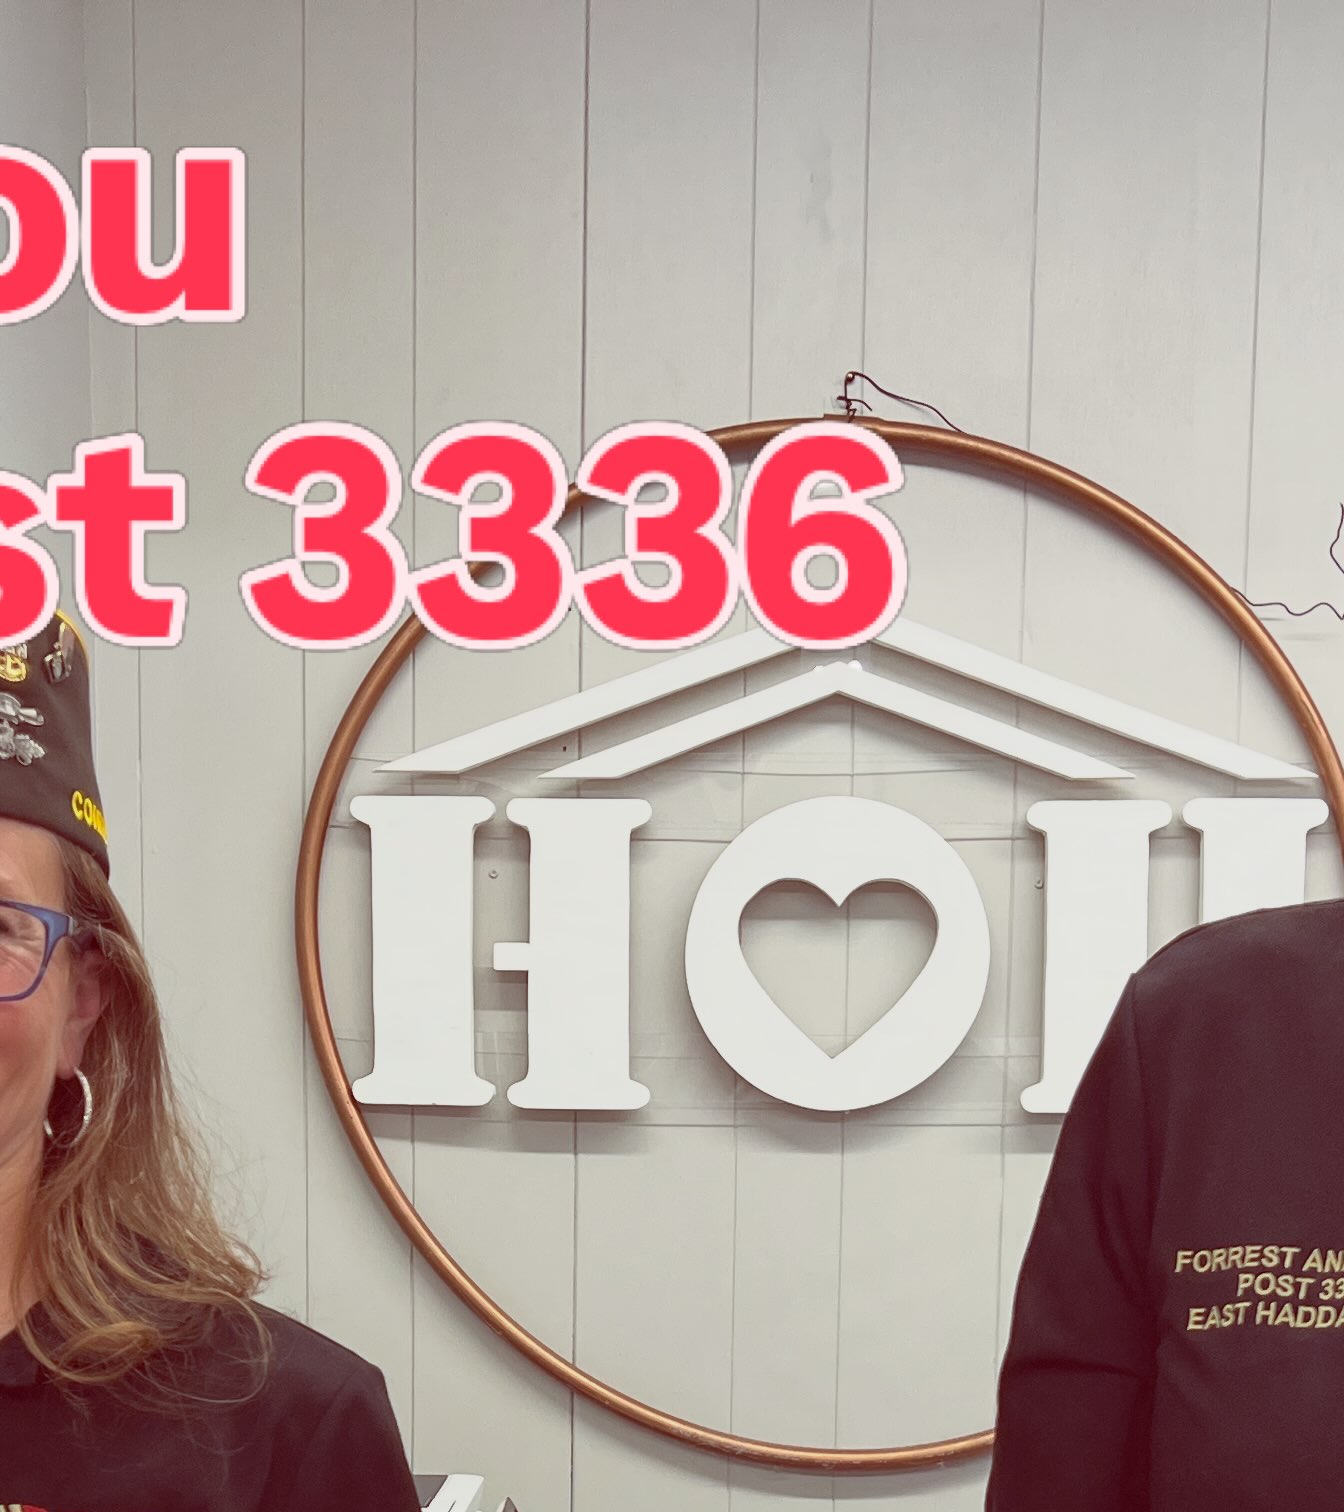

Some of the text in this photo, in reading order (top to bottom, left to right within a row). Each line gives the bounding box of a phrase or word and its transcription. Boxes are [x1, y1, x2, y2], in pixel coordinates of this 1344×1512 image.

[1175, 1245, 1302, 1274] FORREST
[1237, 1272, 1316, 1300] POST
[1187, 1301, 1253, 1331] EAST
